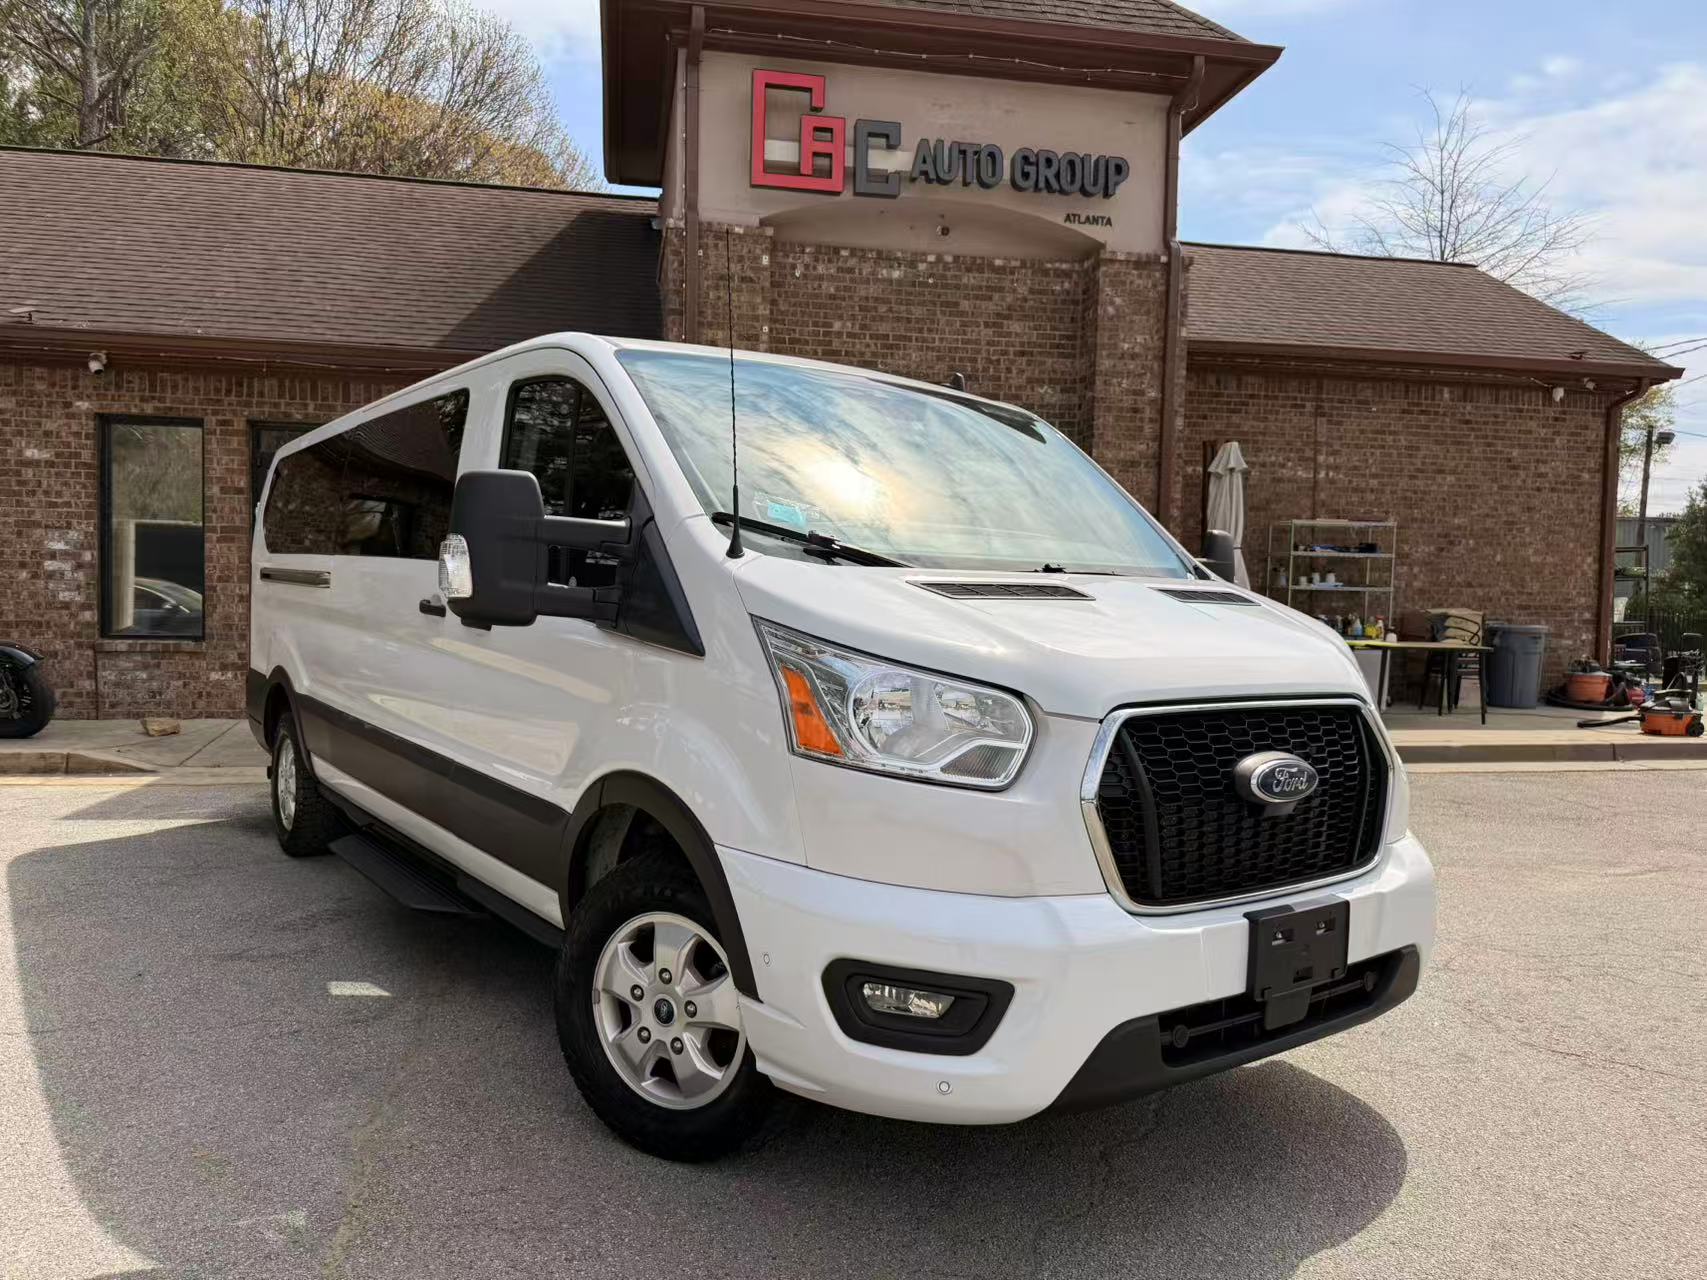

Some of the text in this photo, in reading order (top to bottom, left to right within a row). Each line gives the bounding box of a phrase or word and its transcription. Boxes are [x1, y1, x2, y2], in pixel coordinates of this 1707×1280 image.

[910, 138, 1004, 189] AUTO
[1010, 147, 1130, 199] GROUP
[1064, 213, 1113, 227] ATLANTA
[1272, 767, 1309, 793] Ford
